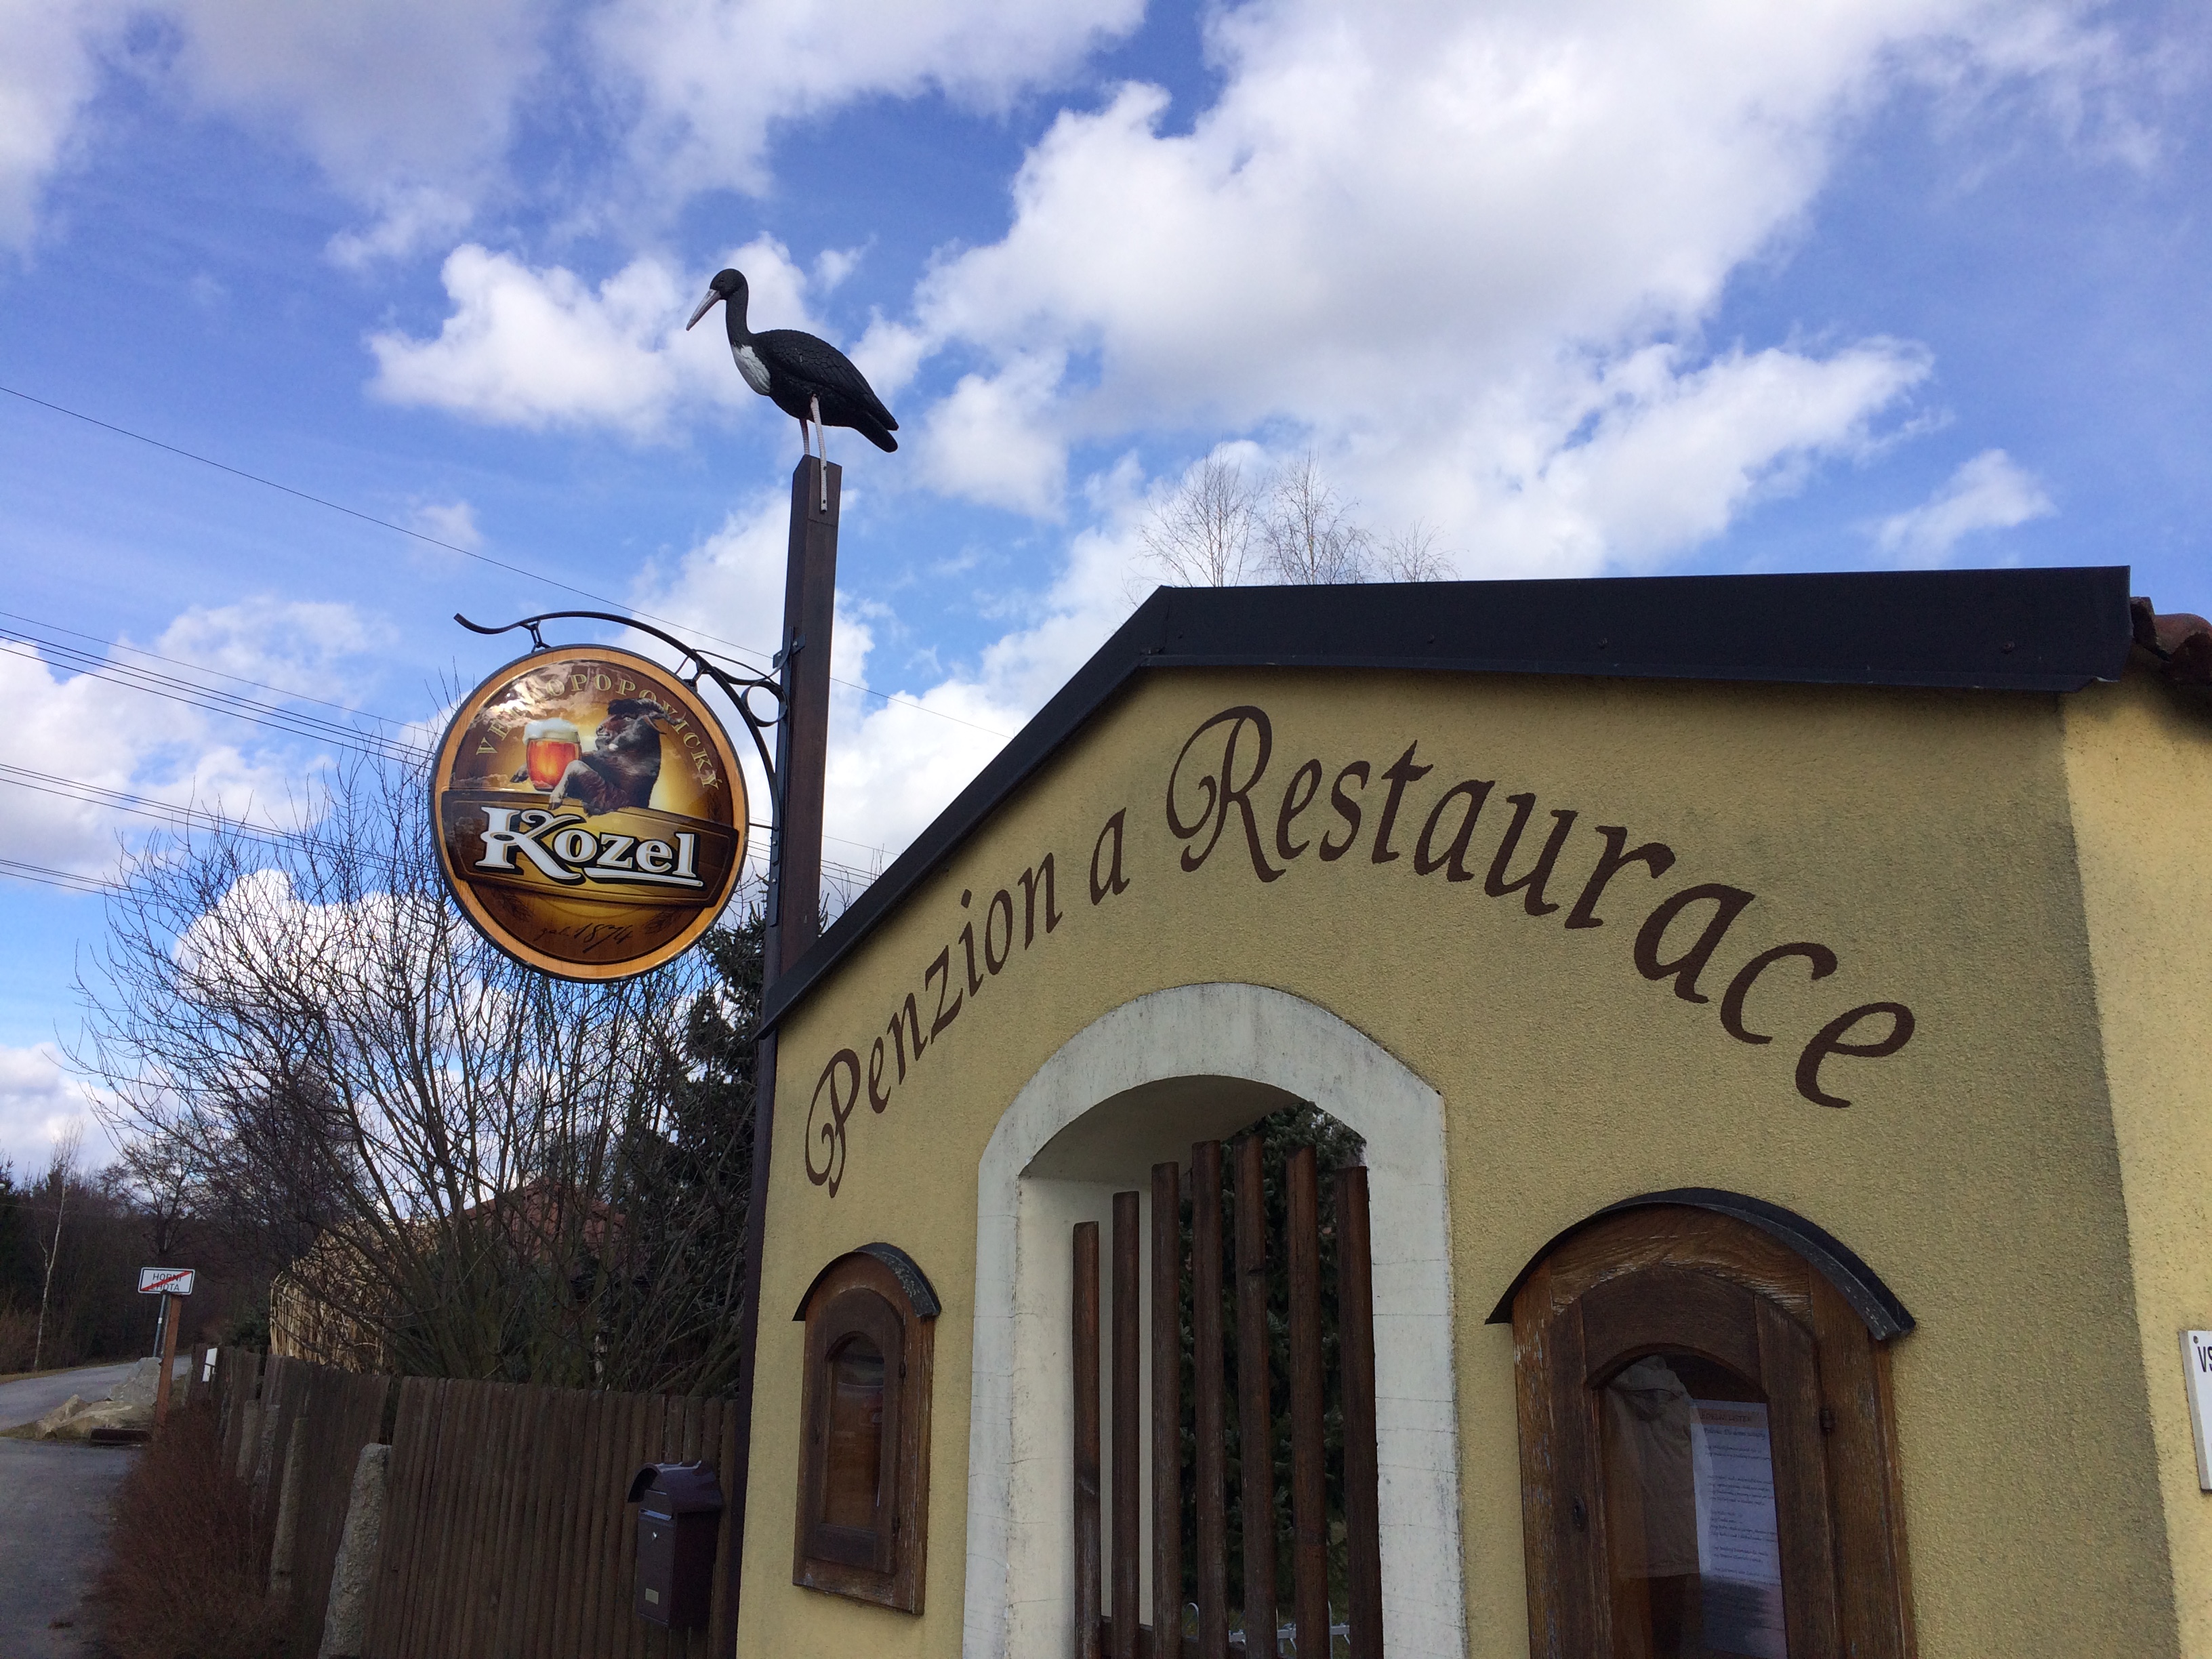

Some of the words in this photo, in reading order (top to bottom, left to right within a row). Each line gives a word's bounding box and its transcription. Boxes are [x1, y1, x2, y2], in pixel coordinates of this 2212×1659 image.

[474, 806, 703, 886] Kozel
[574, 922, 633, 954] 1874
[805, 852, 1063, 1198] Penzion
[1090, 807, 1130, 906] a
[1166, 705, 1916, 1109] Restaurace
